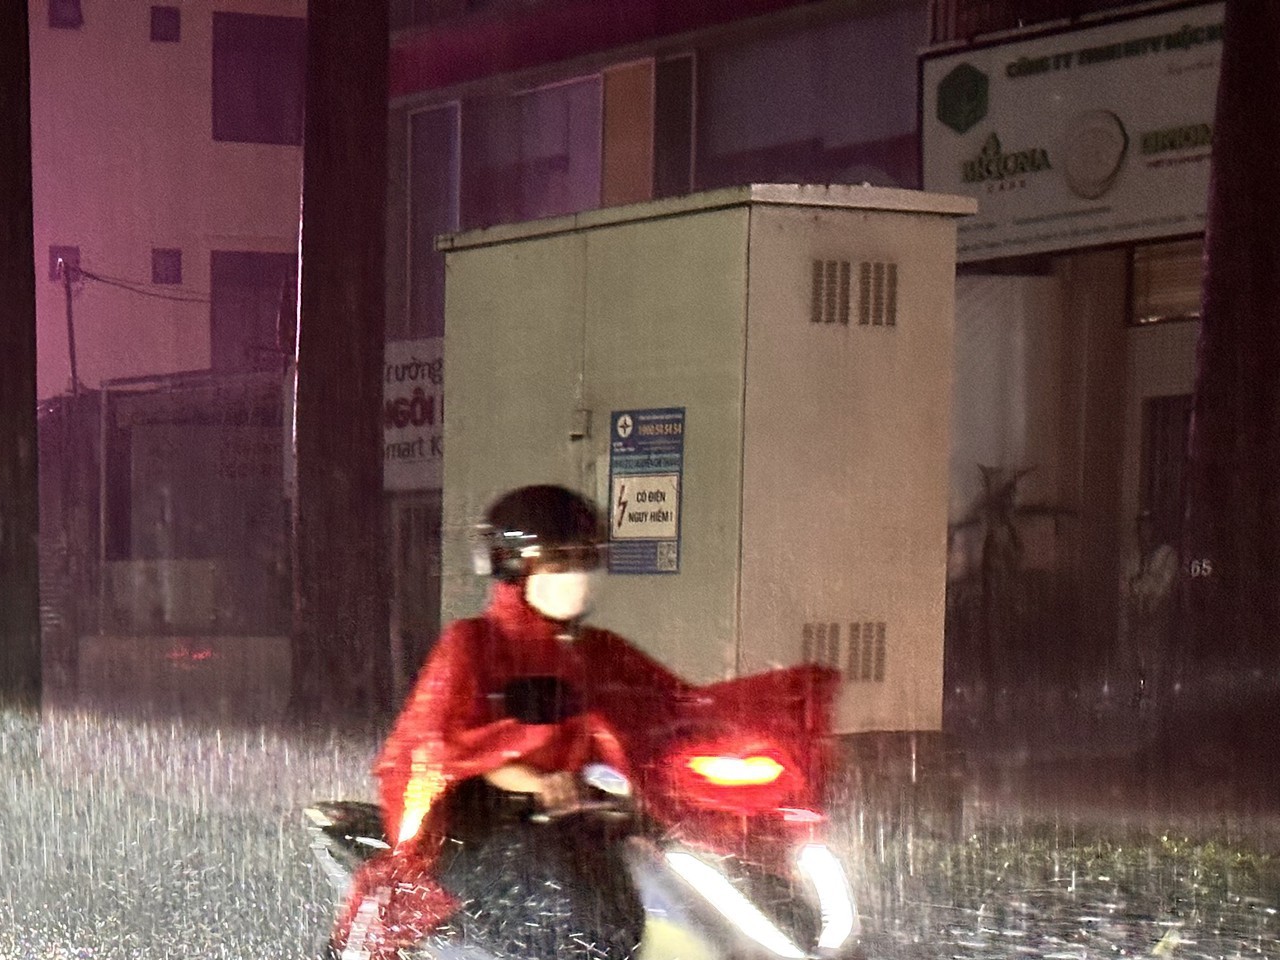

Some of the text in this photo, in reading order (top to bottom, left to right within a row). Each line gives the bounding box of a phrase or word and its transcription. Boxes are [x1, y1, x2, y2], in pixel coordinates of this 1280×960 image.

[384, 357, 443, 385] rường
[385, 436, 424, 459] mart
[628, 510, 648, 523] NGUY
